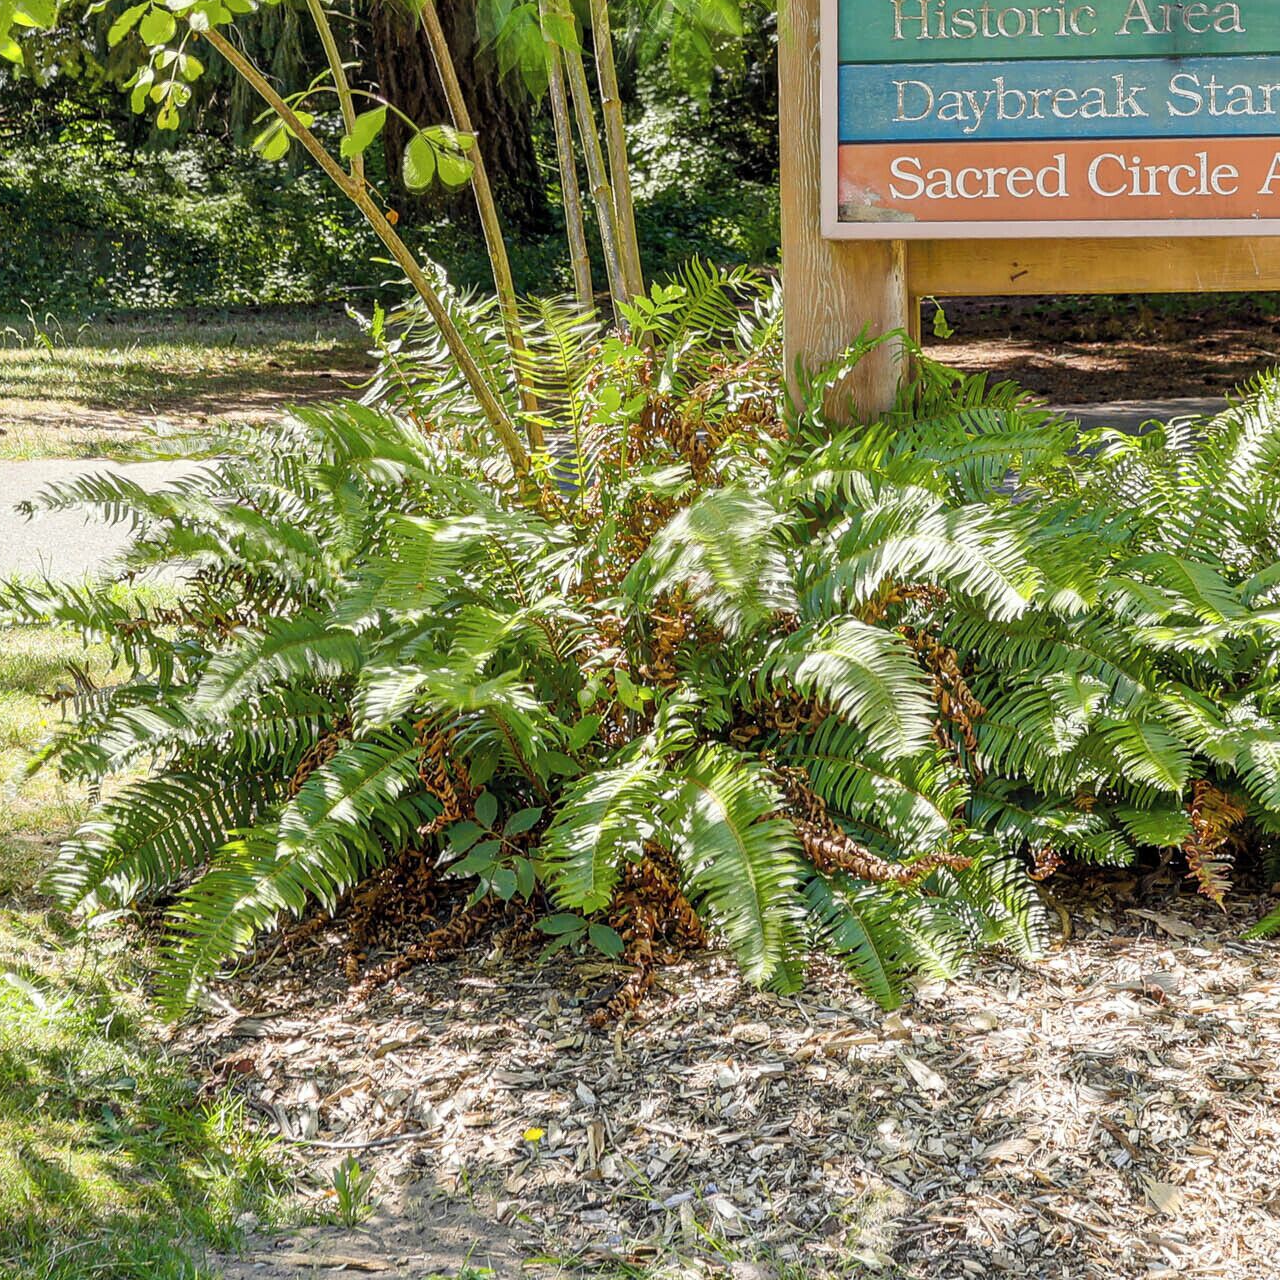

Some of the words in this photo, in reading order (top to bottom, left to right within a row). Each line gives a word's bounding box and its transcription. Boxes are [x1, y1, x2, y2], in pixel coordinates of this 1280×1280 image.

[891, 74, 1150, 135] Daybreak
[888, 152, 1069, 201] Sacred
[1086, 149, 1241, 198] Circle
